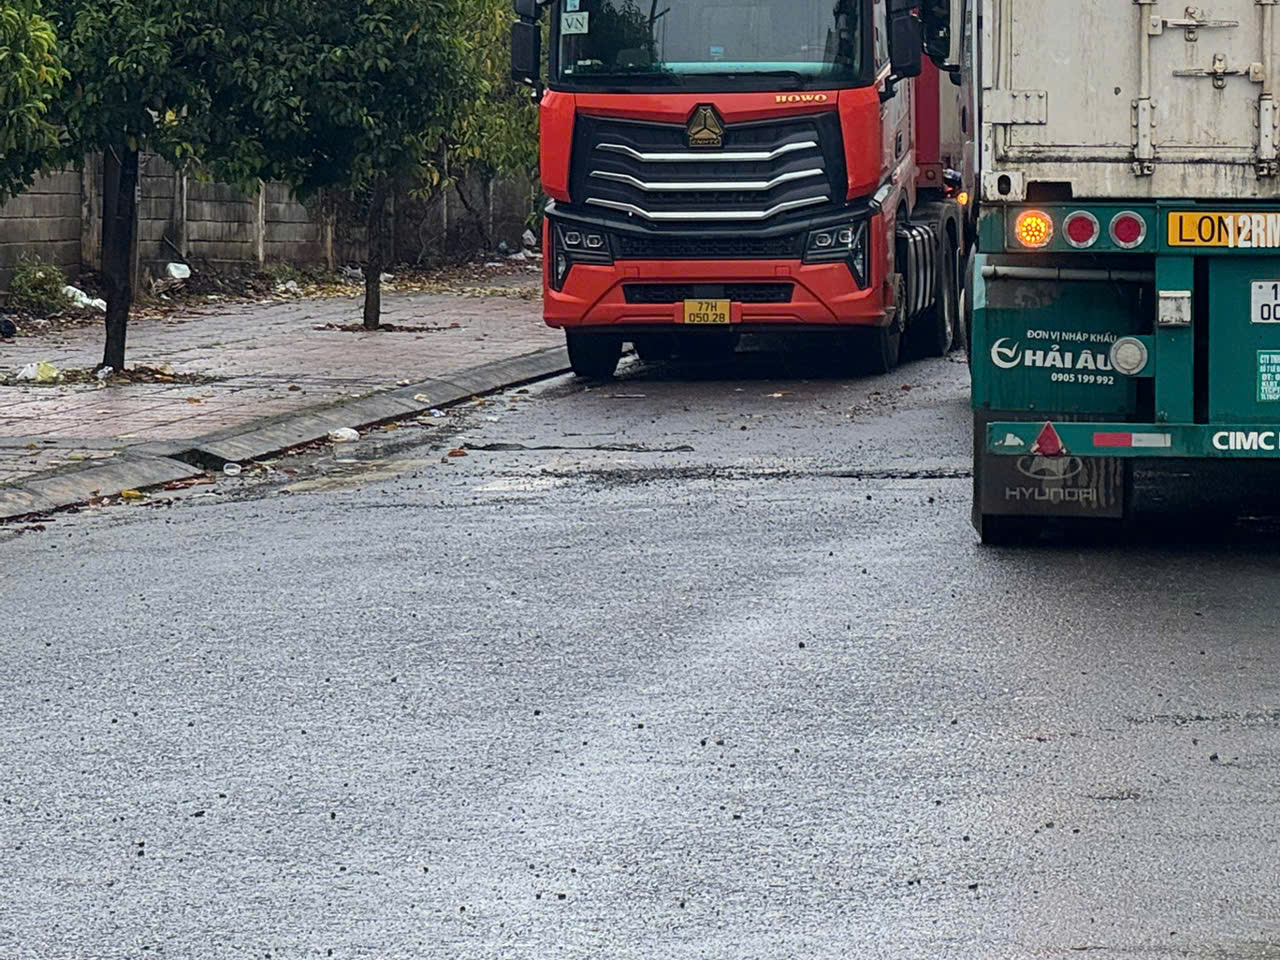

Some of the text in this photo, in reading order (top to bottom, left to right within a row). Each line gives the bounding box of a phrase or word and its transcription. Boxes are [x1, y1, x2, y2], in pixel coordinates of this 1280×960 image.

[564, 17, 585, 30] VN
[775, 93, 828, 103] HOWO
[696, 301, 718, 312] 77H
[688, 312, 726, 323] 050.28
[1026, 329, 1049, 340] ĐƠN
[1050, 330, 1060, 343] VỊ
[1024, 344, 1114, 371] HẢI ÂU
[1051, 372, 1114, 385] 0905 199 992
[1212, 431, 1275, 451] CIMC
[1005, 487, 1097, 501] HYUNDAI
